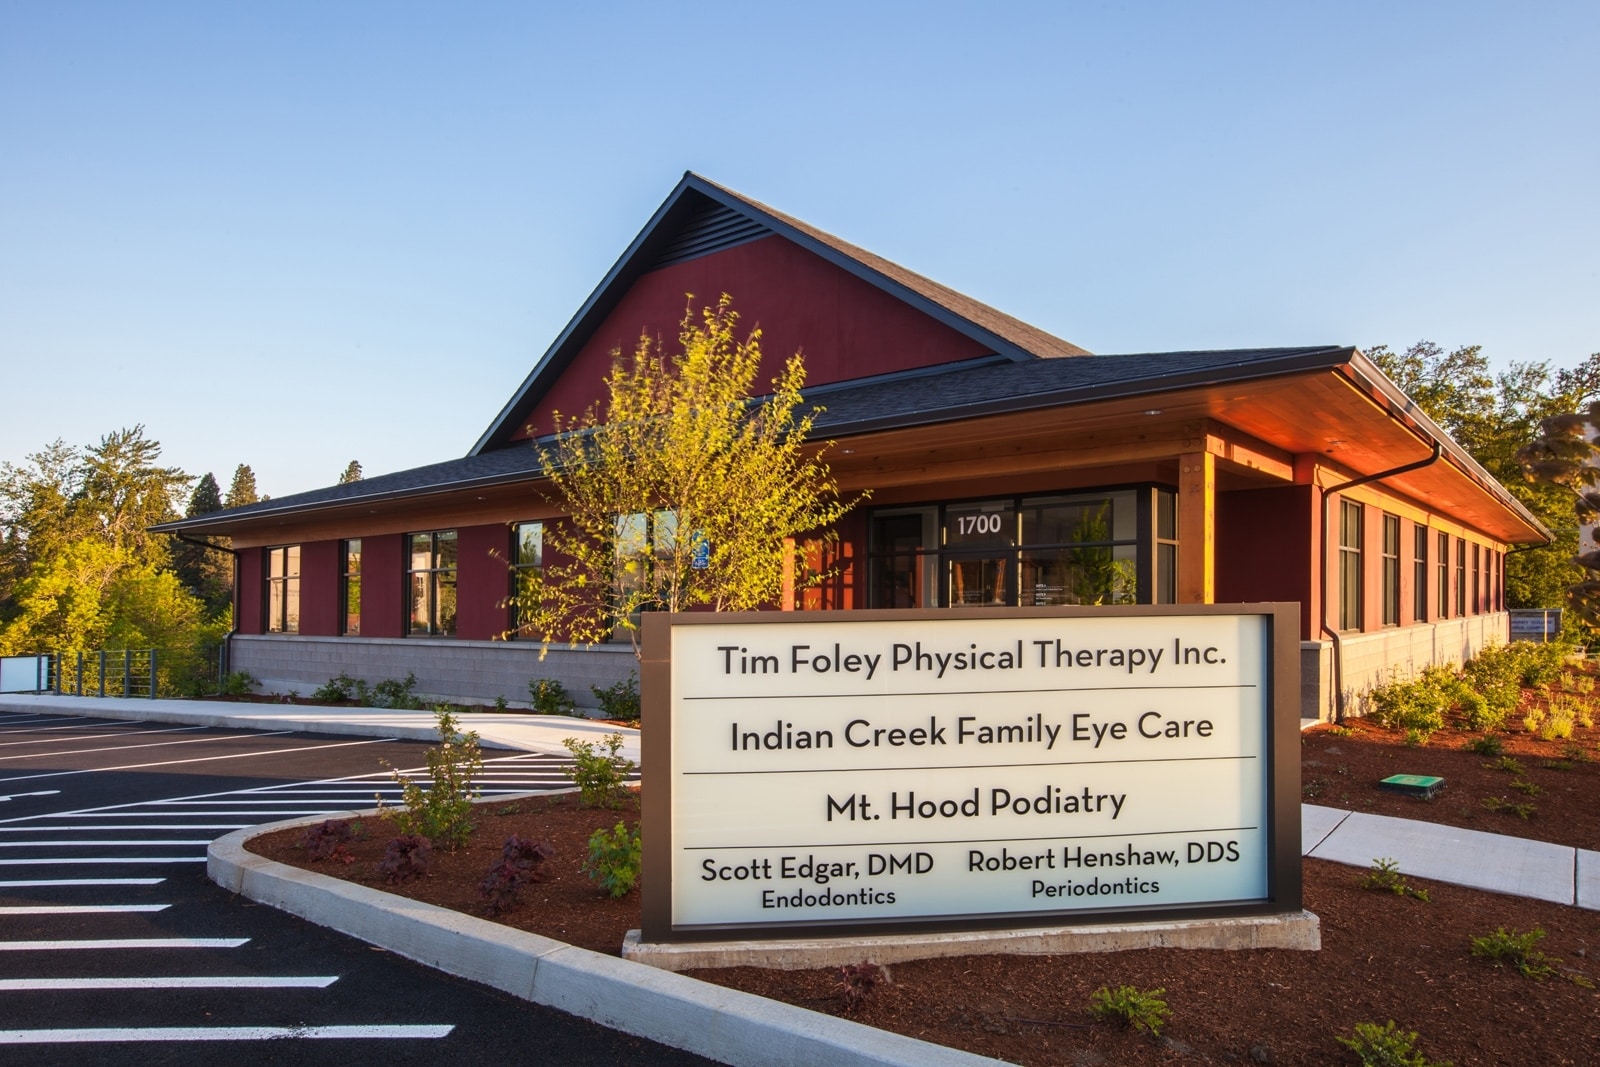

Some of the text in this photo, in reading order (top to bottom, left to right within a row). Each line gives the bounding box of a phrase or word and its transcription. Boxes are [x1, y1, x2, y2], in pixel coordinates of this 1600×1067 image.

[957, 513, 1001, 535] 1700
[717, 638, 1226, 681] Tim Foley Physical Therapy Inc.
[732, 711, 1214, 751] Indian Creek Family Eye Care
[827, 784, 1127, 822] Mt. Hood Podiatry
[701, 851, 934, 885] Scott Edgar, DMD
[968, 840, 1240, 873] Robert Henshaw, DDS
[761, 886, 897, 909] Endodontics
[1031, 876, 1160, 899] Periodontics
